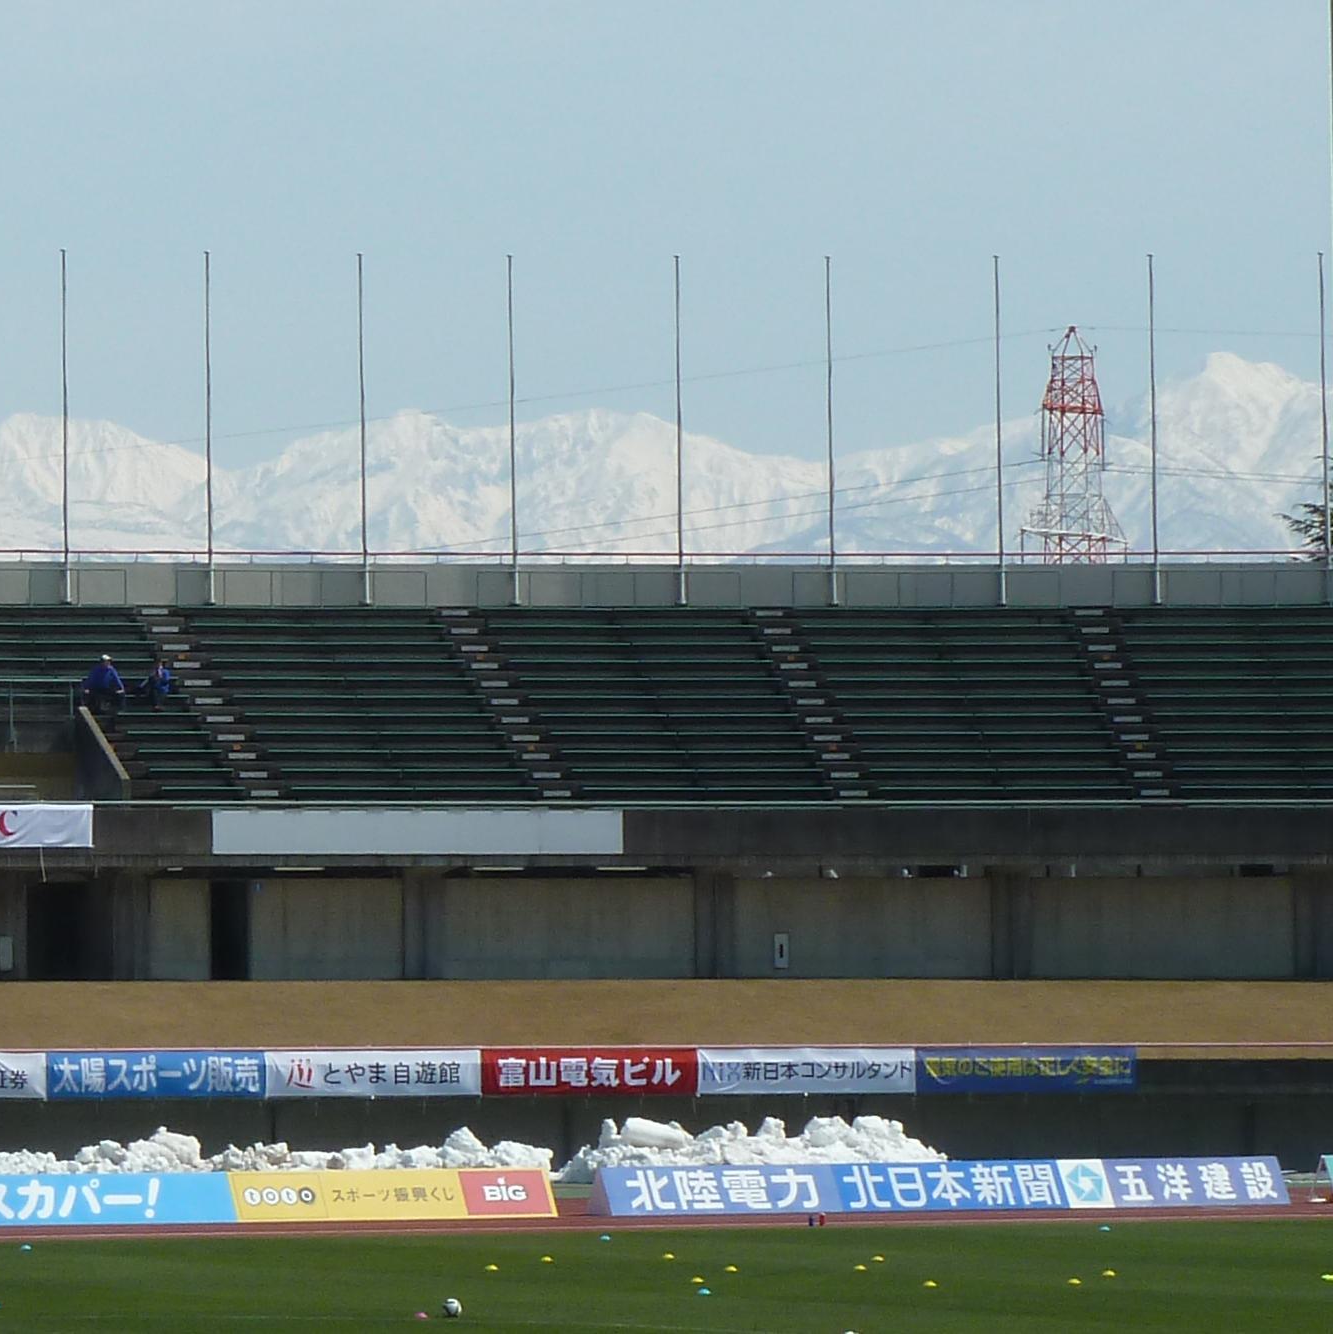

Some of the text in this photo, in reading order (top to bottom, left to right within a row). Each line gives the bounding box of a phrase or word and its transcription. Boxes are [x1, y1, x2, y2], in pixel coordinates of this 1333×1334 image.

[53, 1056, 261, 1094] 太陽スポーツ販売
[324, 1062, 461, 1085] とやま自遊館
[498, 1057, 683, 1087] 富山電気ビル
[242, 1186, 316, 1206] toto
[624, 1167, 820, 1212] 北陸電力
[842, 1163, 1062, 1210] 北日本新聞
[1116, 1160, 1280, 1202] 五洋建設
